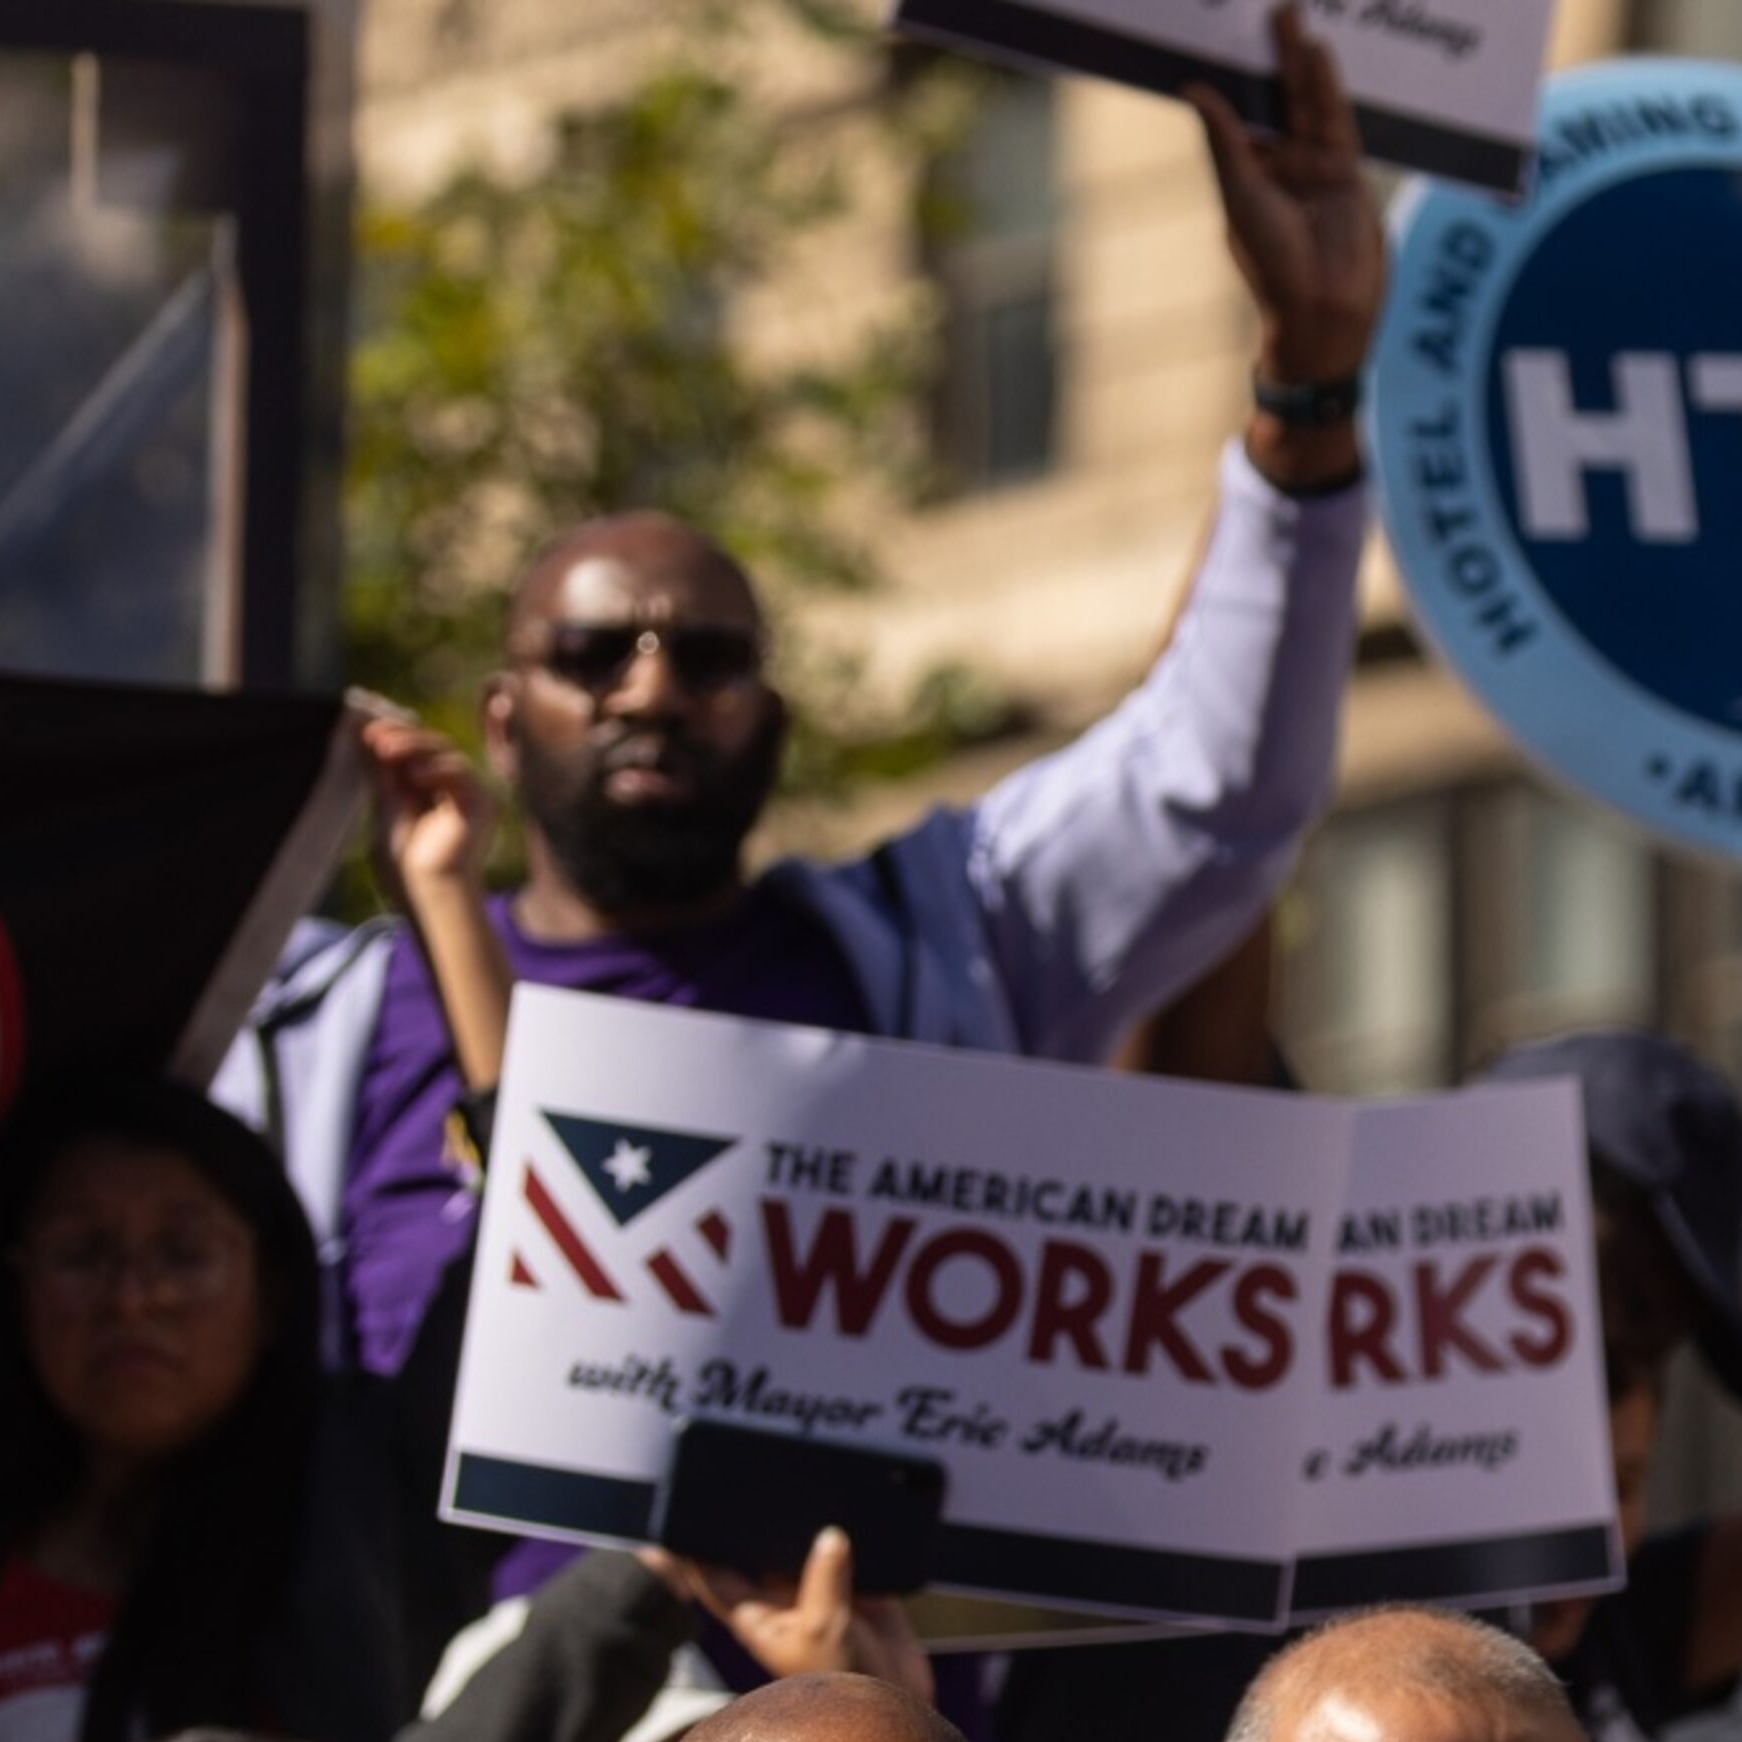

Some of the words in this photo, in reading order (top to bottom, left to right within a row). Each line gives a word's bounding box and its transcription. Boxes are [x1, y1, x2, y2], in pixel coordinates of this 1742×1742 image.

[1532, 93, 1742, 192] AMING
[1410, 222, 1495, 374] AND
[1406, 410, 1539, 661] HOTEL
[764, 1141, 853, 1193] THE
[868, 1160, 1136, 1238] AMERICAN
[1150, 1199, 1311, 1253] DREAM
[1410, 1190, 1565, 1250] DREAM
[760, 1195, 1301, 1394] WORKS
[1328, 1244, 1574, 1393] RKS
[567, 1355, 680, 1413] with
[693, 1359, 885, 1434] Mayor
[895, 1385, 1009, 1452] Eric
[1020, 1407, 1212, 1484] Adams
[1342, 1420, 1521, 1473] Adams
